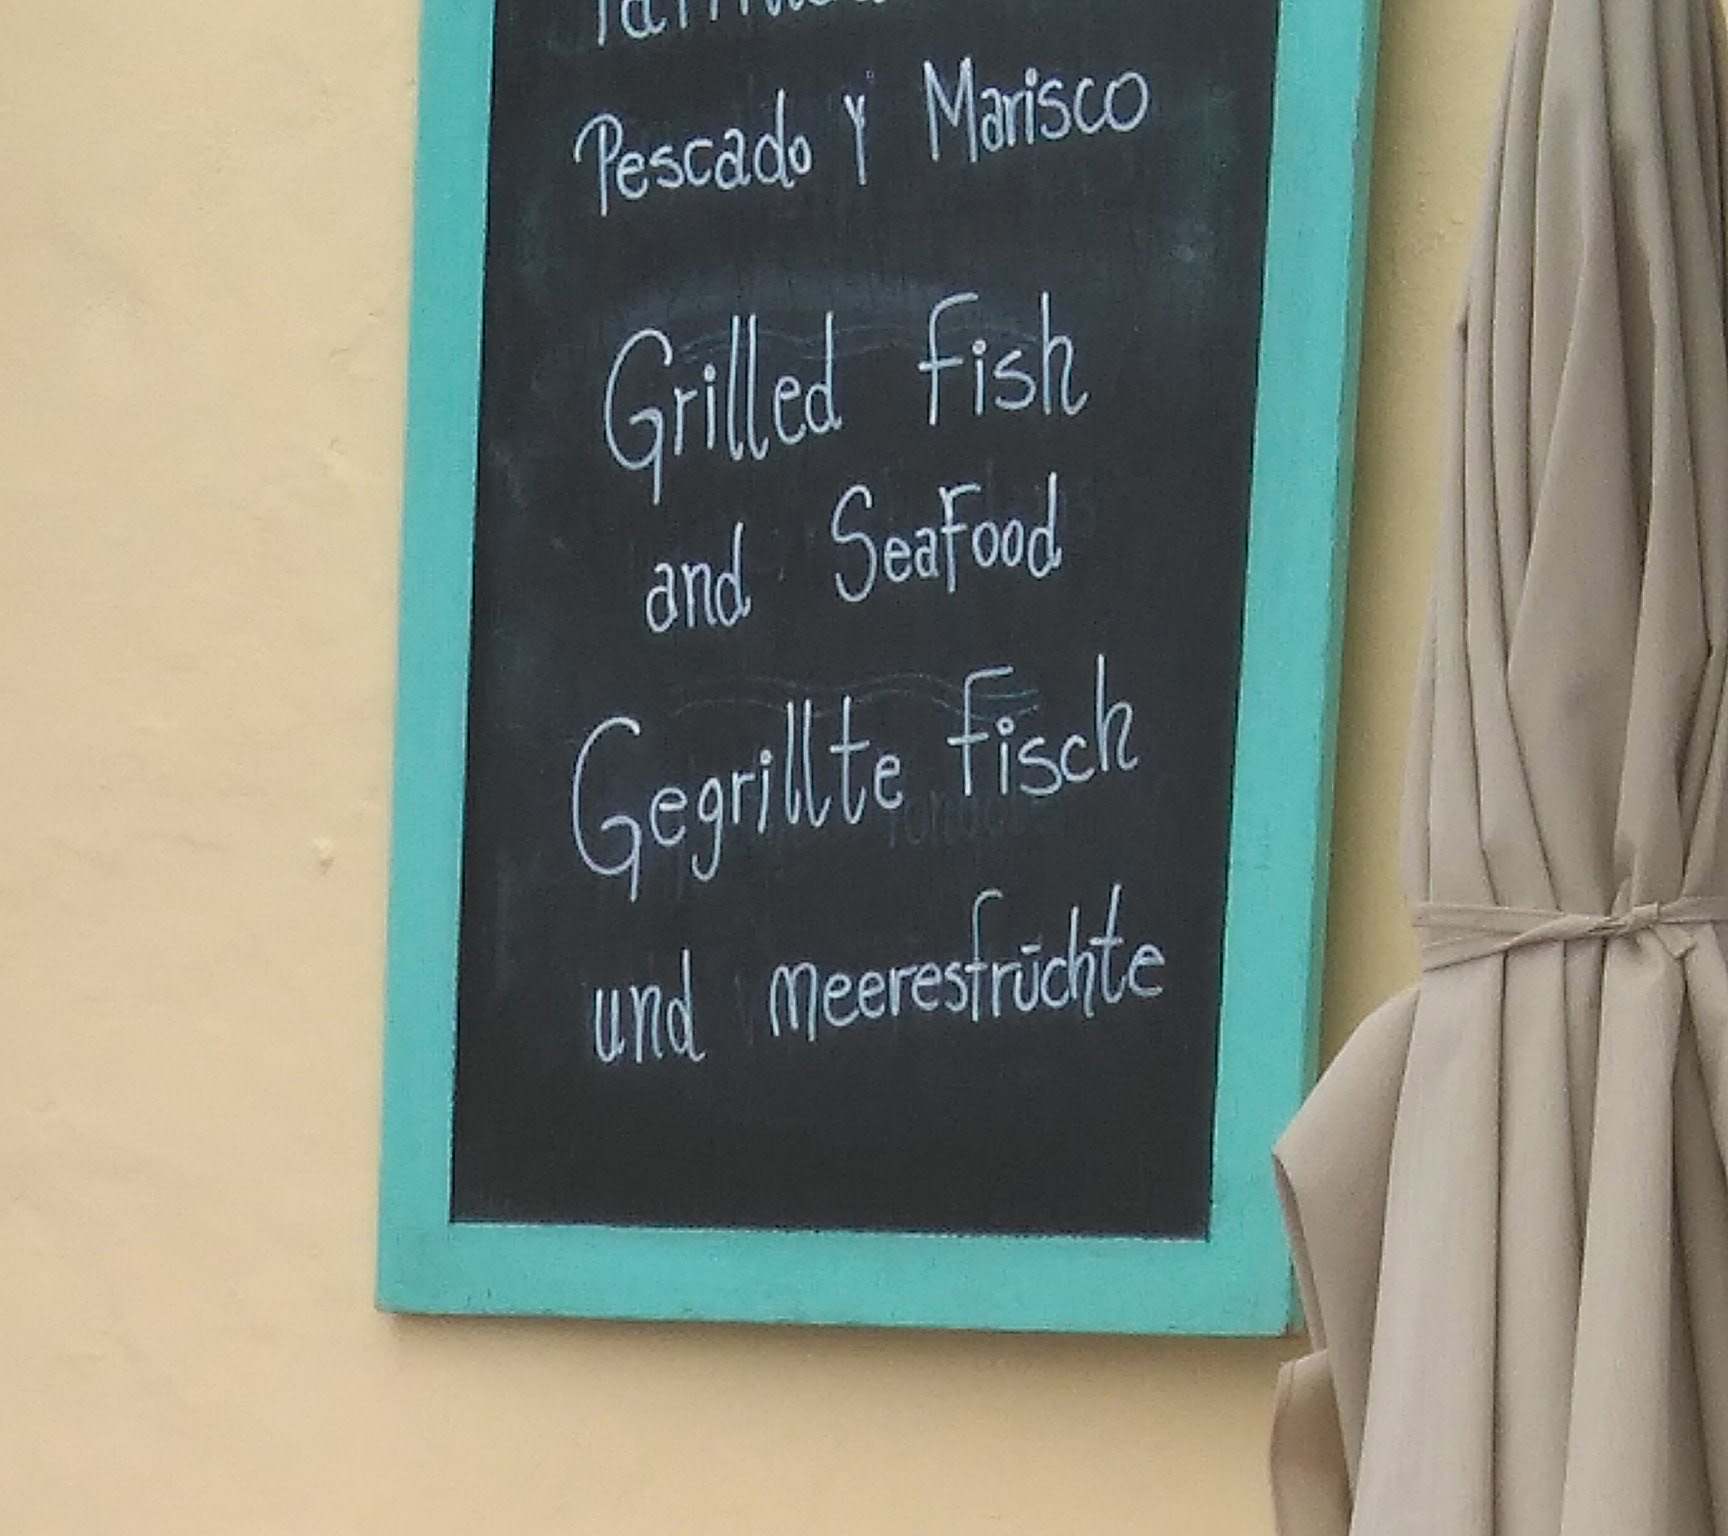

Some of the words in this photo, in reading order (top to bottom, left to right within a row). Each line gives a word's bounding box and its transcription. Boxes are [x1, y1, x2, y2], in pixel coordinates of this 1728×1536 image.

[573, 88, 813, 218] Pescado
[922, 56, 1150, 164] Marisco
[604, 310, 842, 507] Grilled
[645, 520, 752, 634] and
[571, 694, 904, 903] Gegrillte
[594, 948, 707, 1064] und
